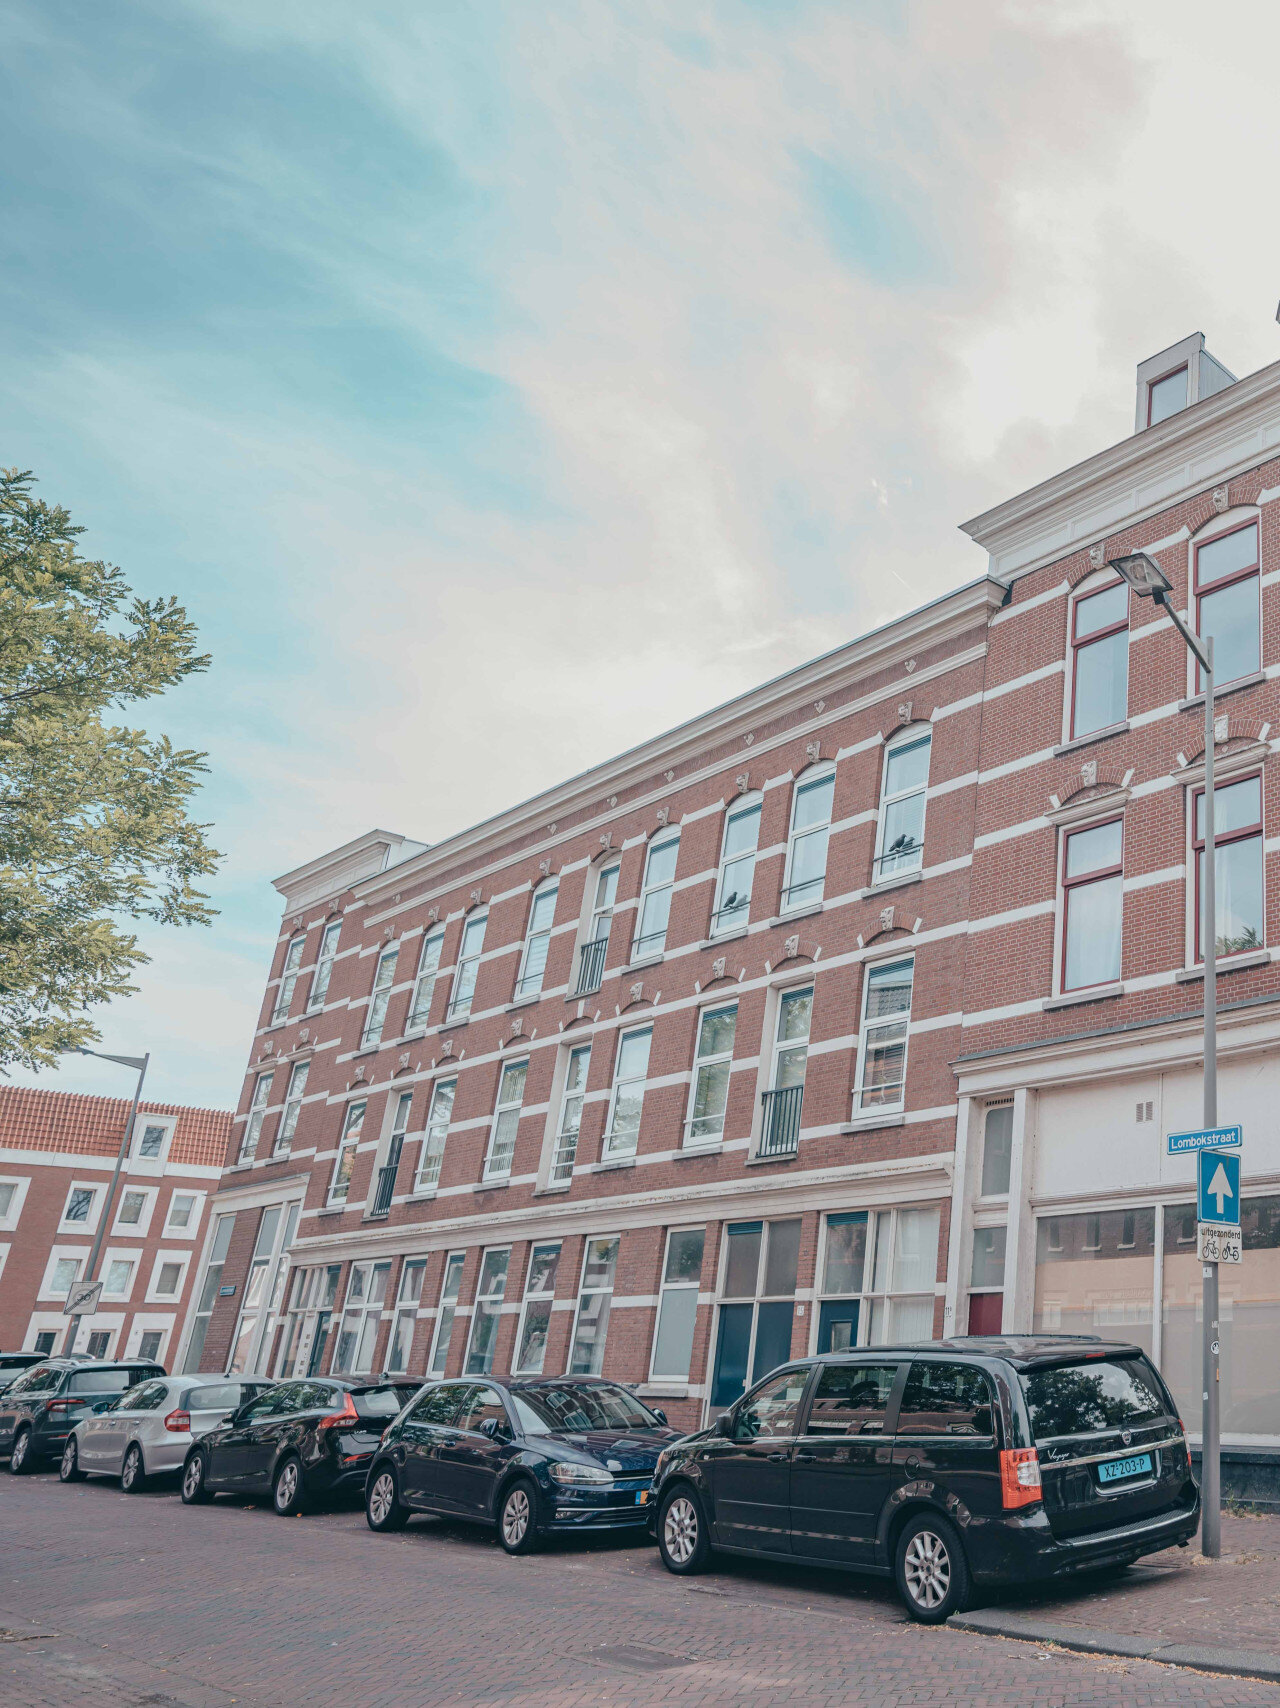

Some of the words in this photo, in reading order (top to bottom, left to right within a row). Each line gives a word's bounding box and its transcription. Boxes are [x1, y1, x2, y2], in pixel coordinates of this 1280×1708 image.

[1171, 1130, 1236, 1149] Lombokstraat
[1201, 1227, 1241, 1240] uitgezonderd
[1047, 1447, 1070, 1462] Voyager
